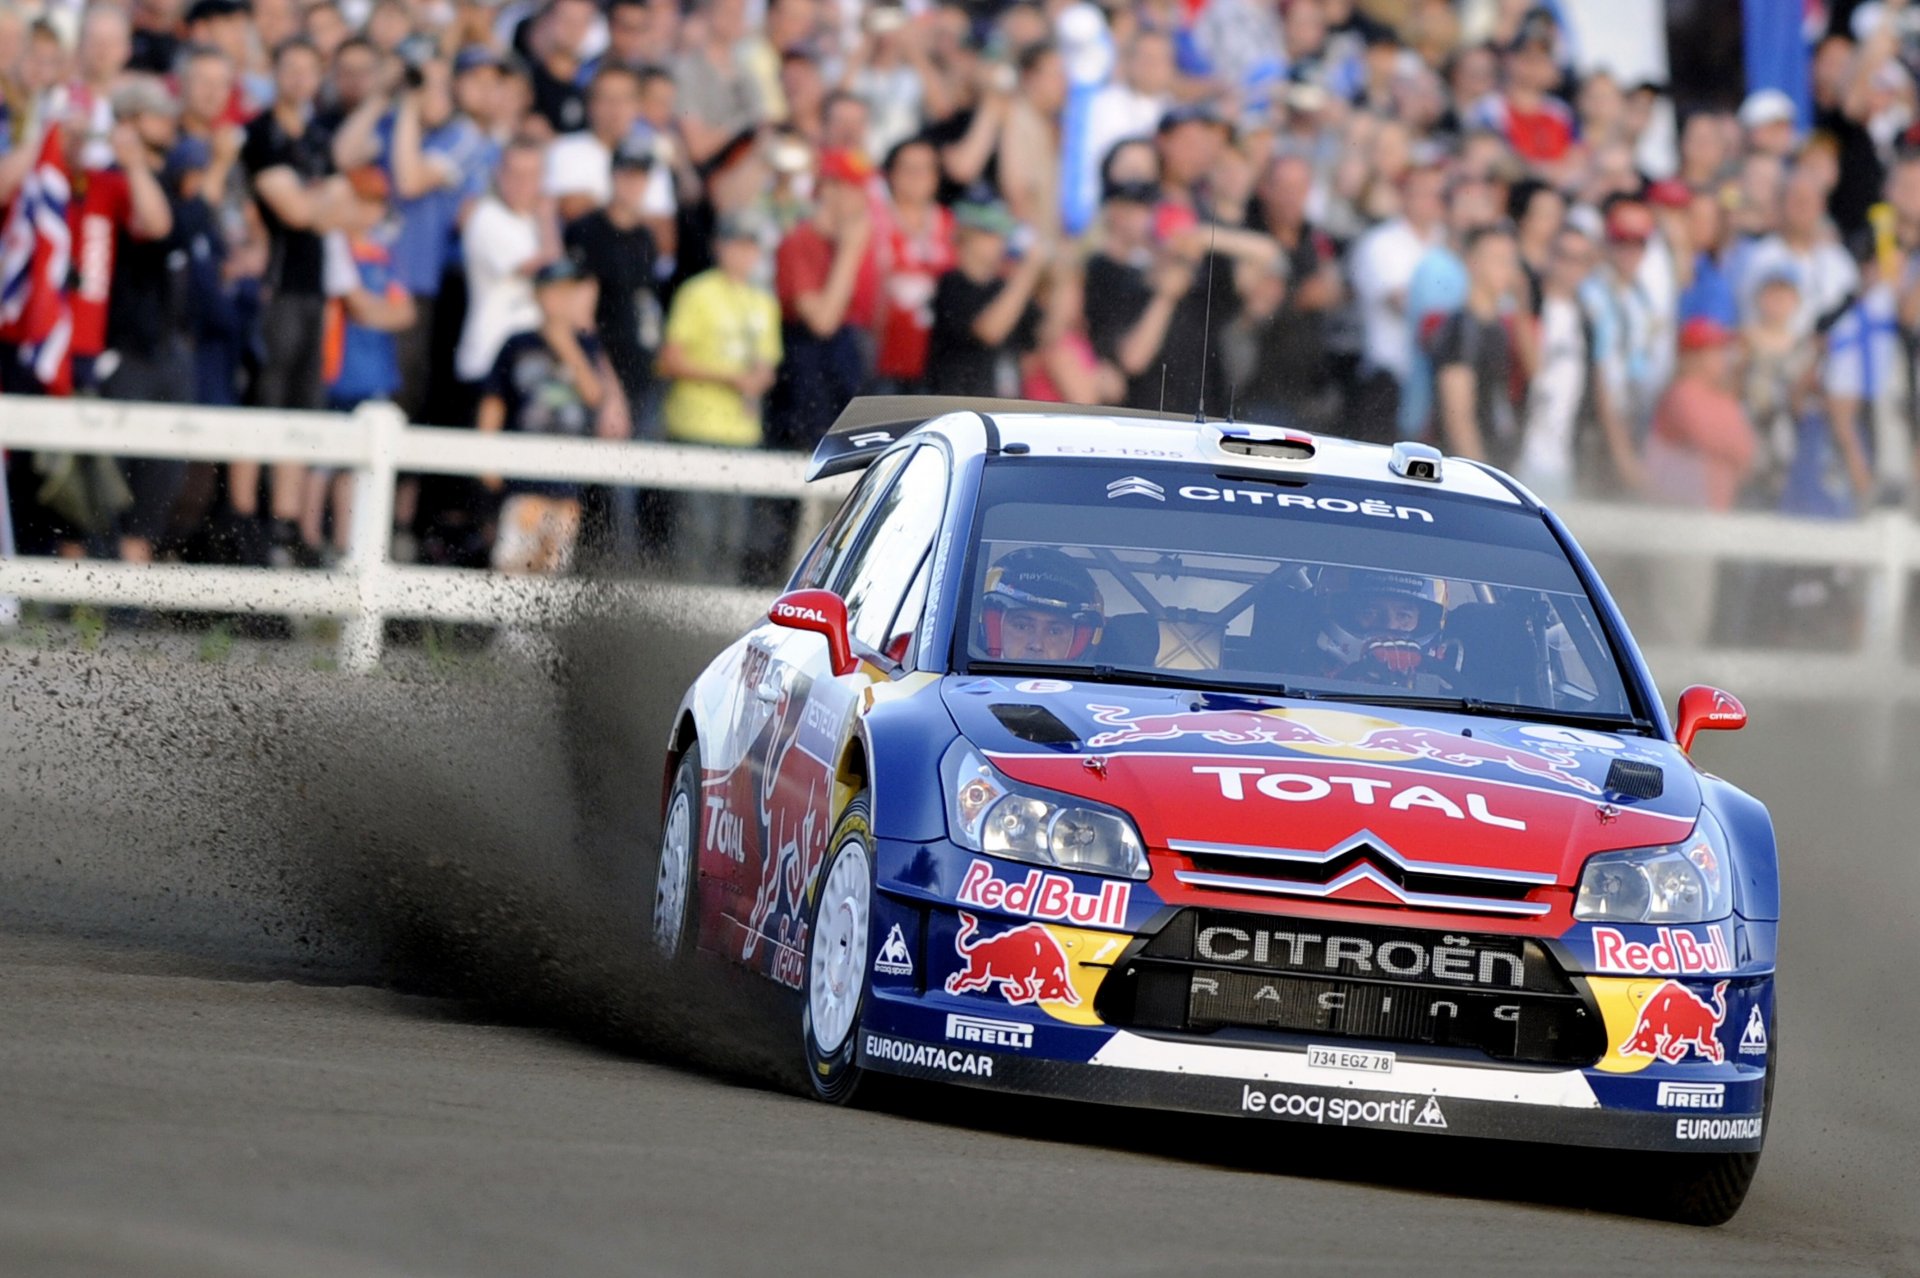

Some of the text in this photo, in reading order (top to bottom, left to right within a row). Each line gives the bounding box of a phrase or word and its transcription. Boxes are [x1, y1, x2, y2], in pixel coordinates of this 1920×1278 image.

[776, 602, 827, 623] TOTAL
[1192, 766, 1527, 831] TOTAL
[706, 795, 746, 863] TOTAL
[956, 859, 1132, 928] Red Bull
[1198, 926, 1525, 988] CITROËN
[1592, 925, 1732, 974] Red Bull
[945, 1013, 1034, 1049] PIRELLI
[866, 1035, 994, 1078] EURODATACAR
[1312, 1051, 1390, 1071] 734 EGZ 78
[1242, 1084, 1416, 1127] le coq sportif
[1656, 1081, 1726, 1108] PIRELLI
[1676, 1118, 1763, 1140] EURODATACAR
